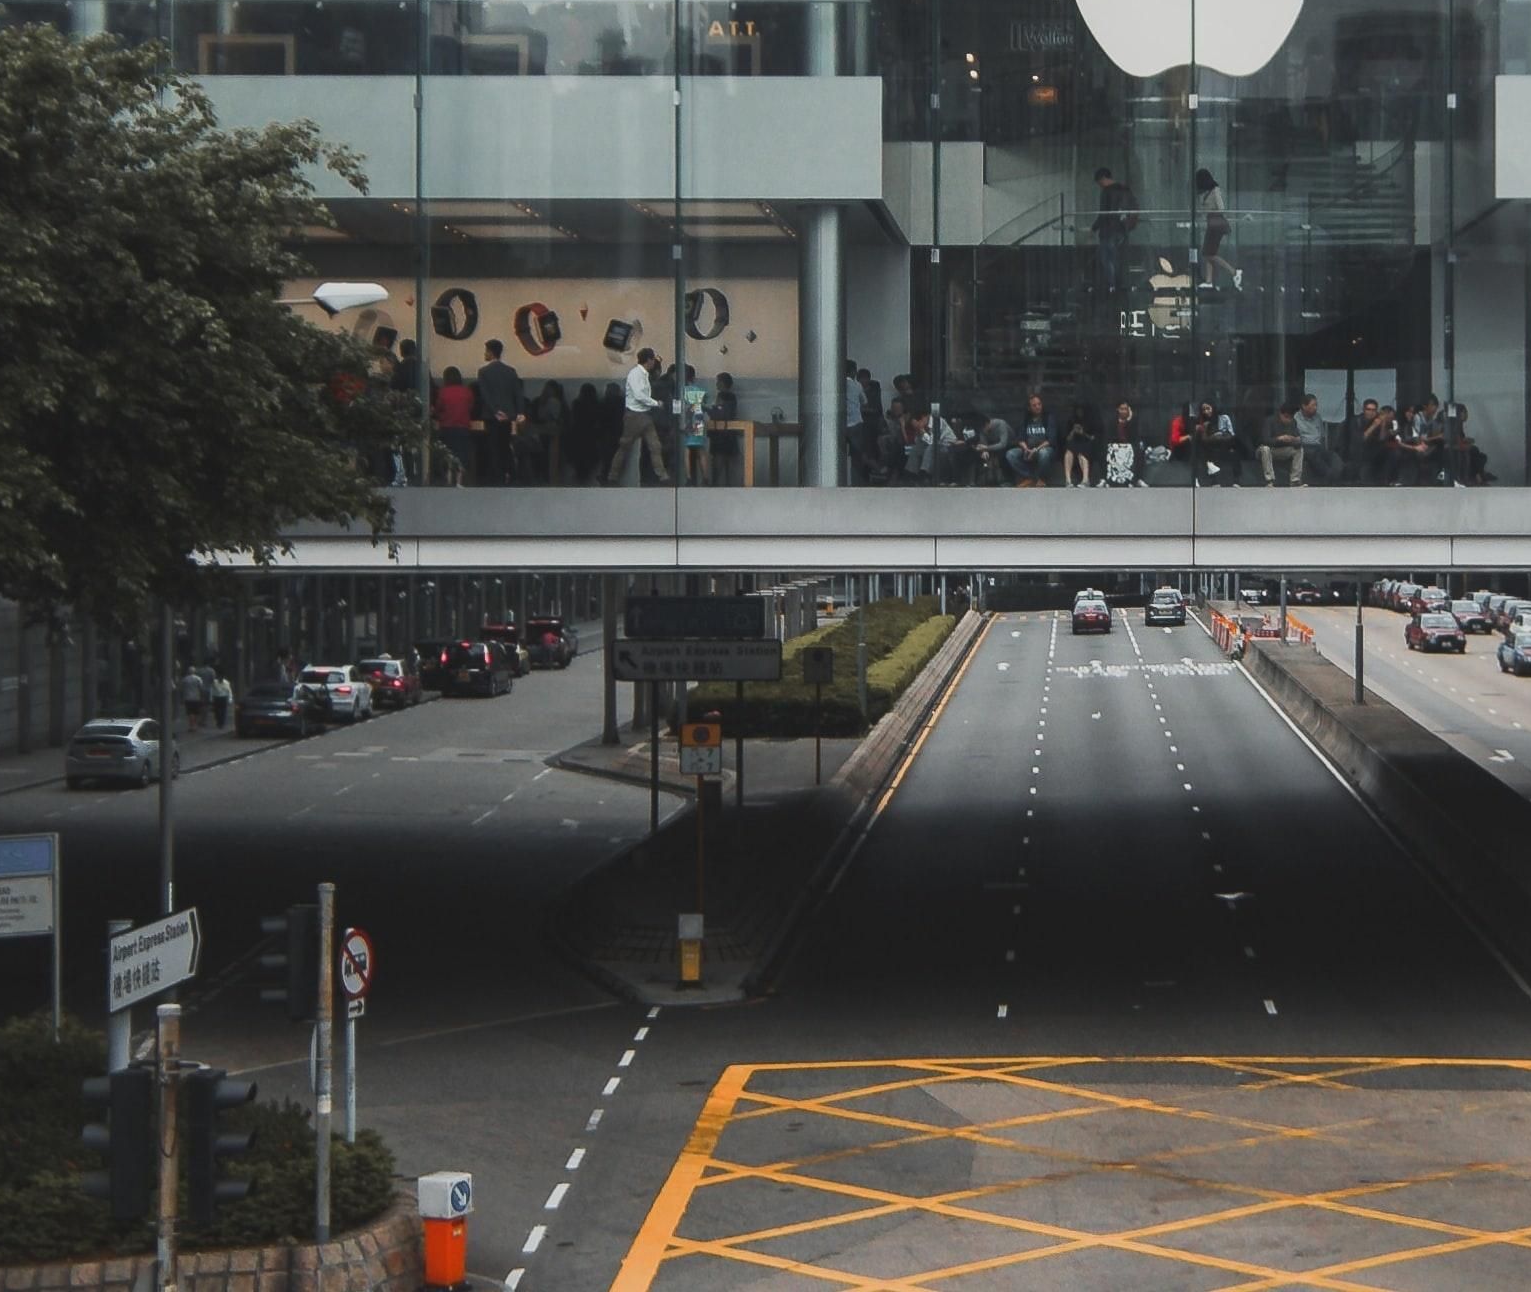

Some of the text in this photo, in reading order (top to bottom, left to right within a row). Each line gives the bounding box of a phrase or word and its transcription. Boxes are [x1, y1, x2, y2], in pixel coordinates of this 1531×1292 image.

[641, 645, 778, 657] Airport Express Station
[113, 921, 189, 963] Airport Express Station
